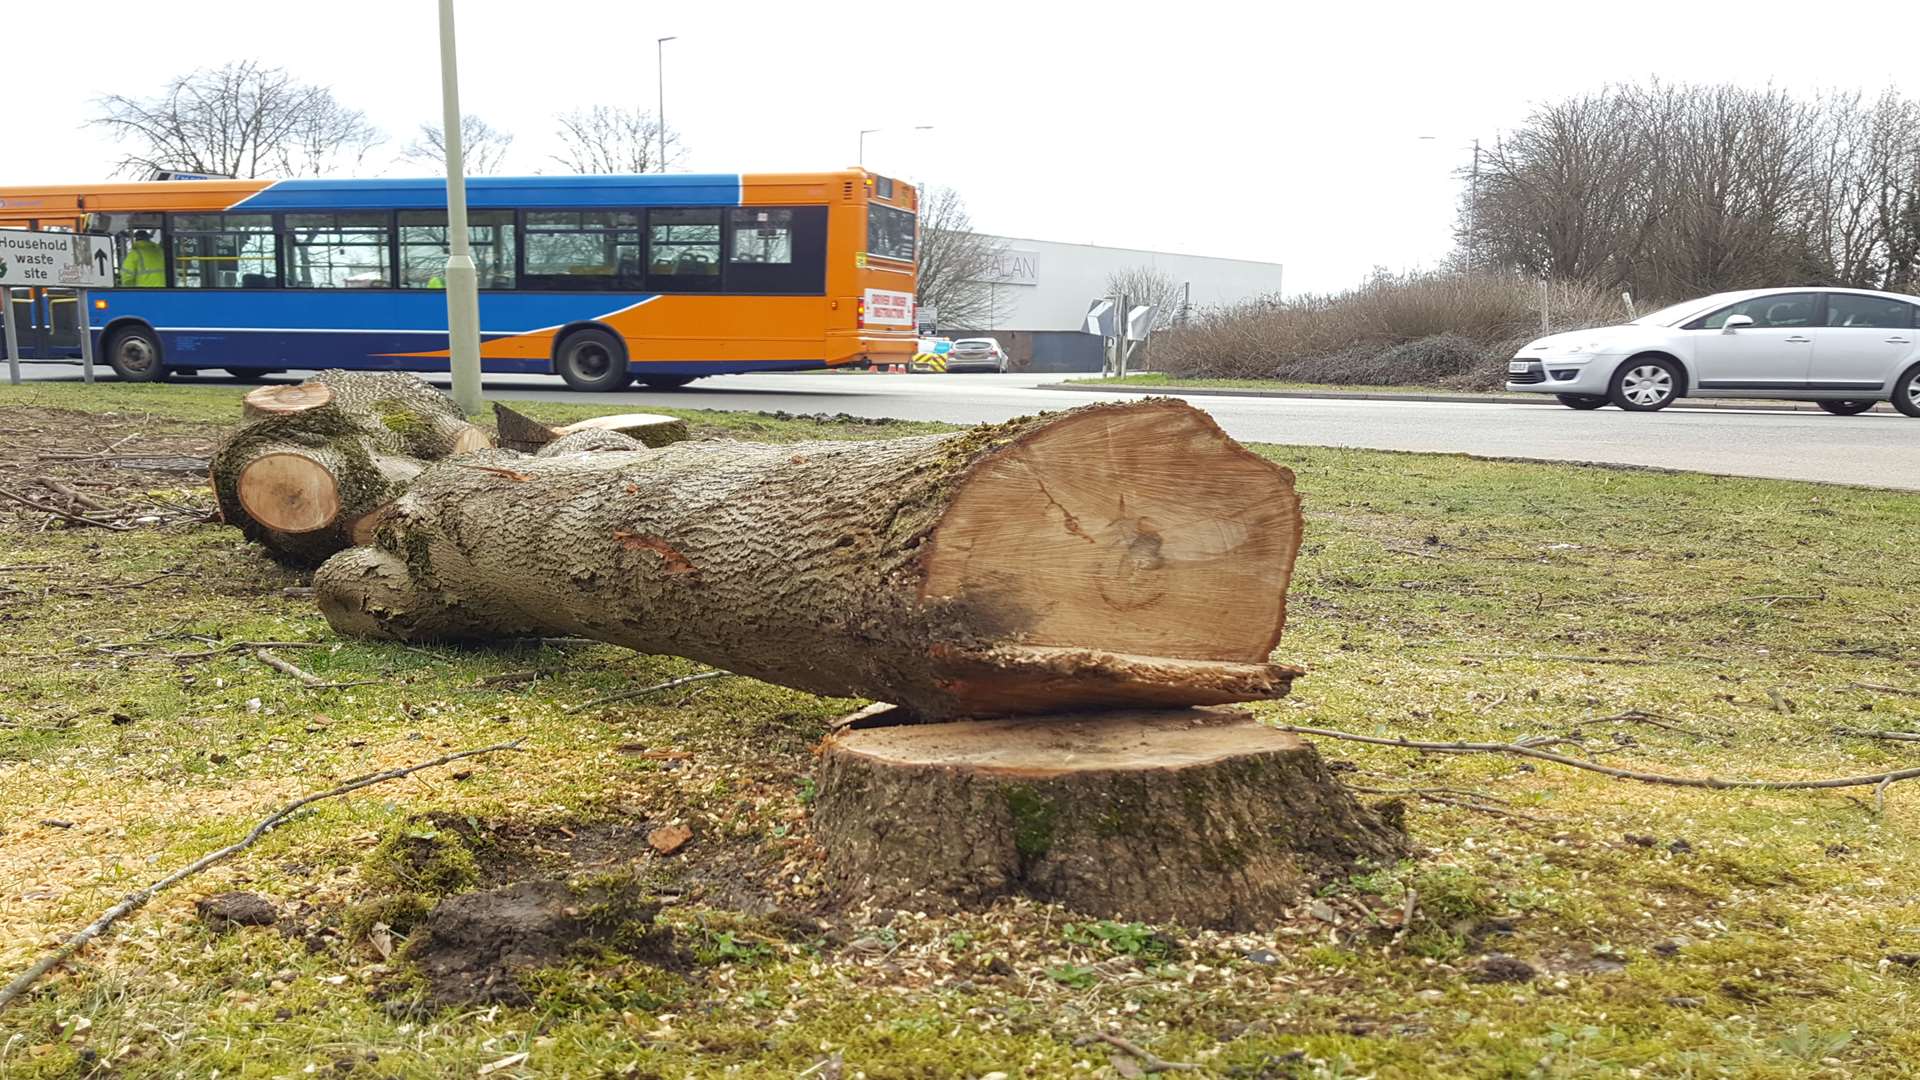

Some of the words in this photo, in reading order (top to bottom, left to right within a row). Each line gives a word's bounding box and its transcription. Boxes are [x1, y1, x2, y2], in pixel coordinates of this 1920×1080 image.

[0, 236, 67, 251] Household
[15, 254, 54, 265] waste
[24, 268, 48, 279] site
